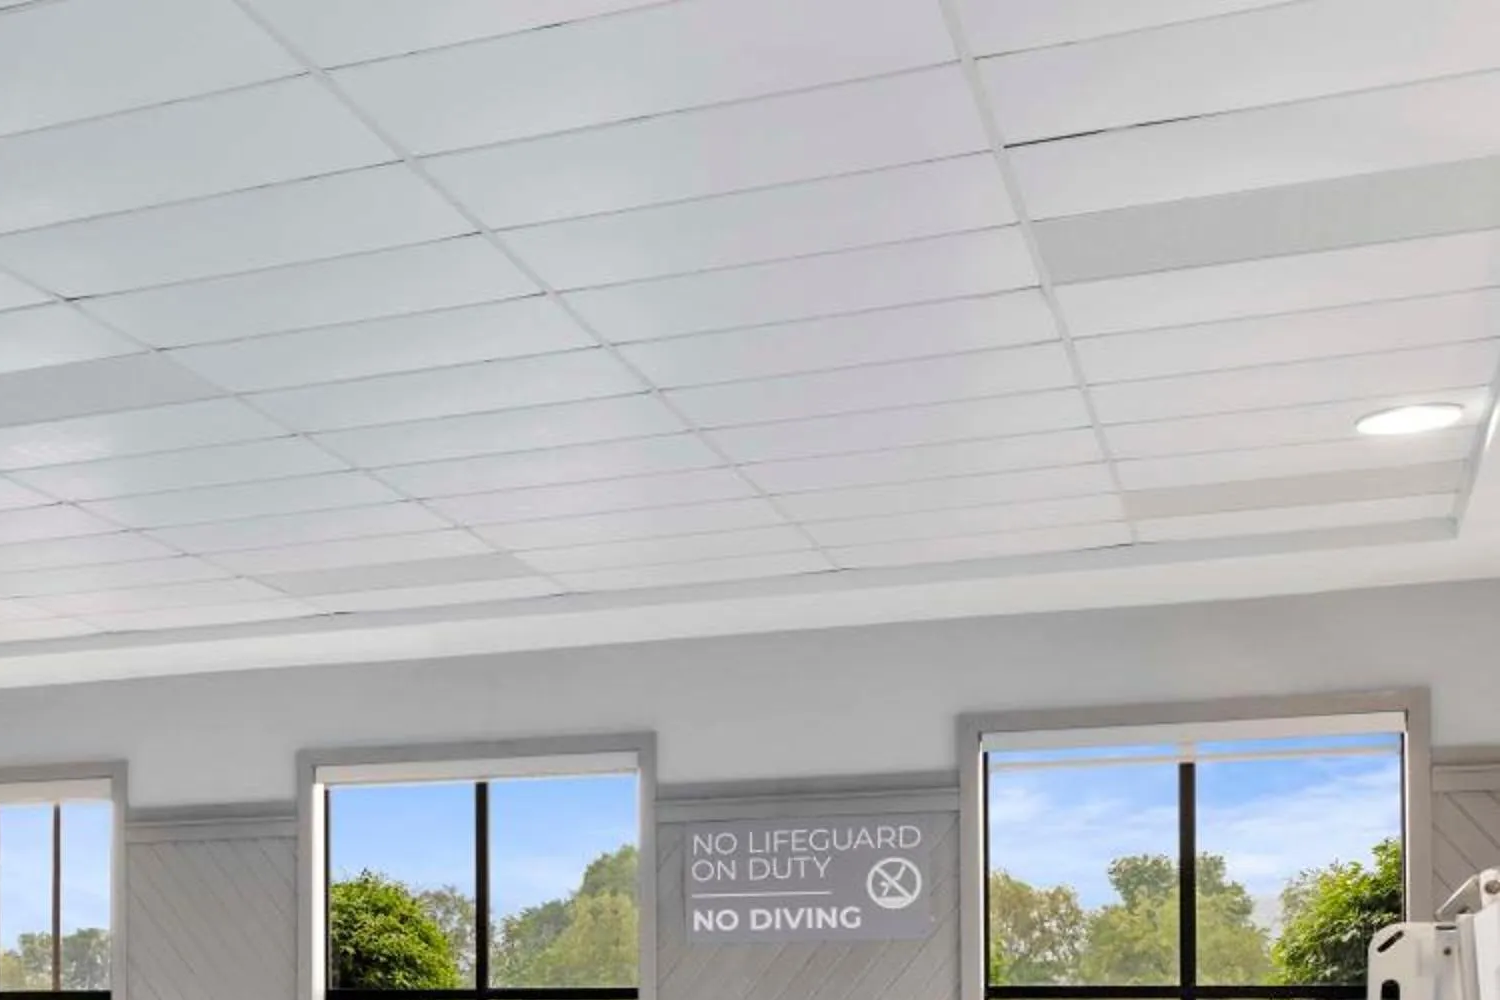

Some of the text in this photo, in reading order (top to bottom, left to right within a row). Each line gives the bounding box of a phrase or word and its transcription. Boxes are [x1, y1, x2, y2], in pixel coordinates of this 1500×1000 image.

[693, 825, 921, 855] NO LIFEGUARD
[691, 856, 832, 882] ON DUTY
[693, 906, 862, 931] NO DIVING
